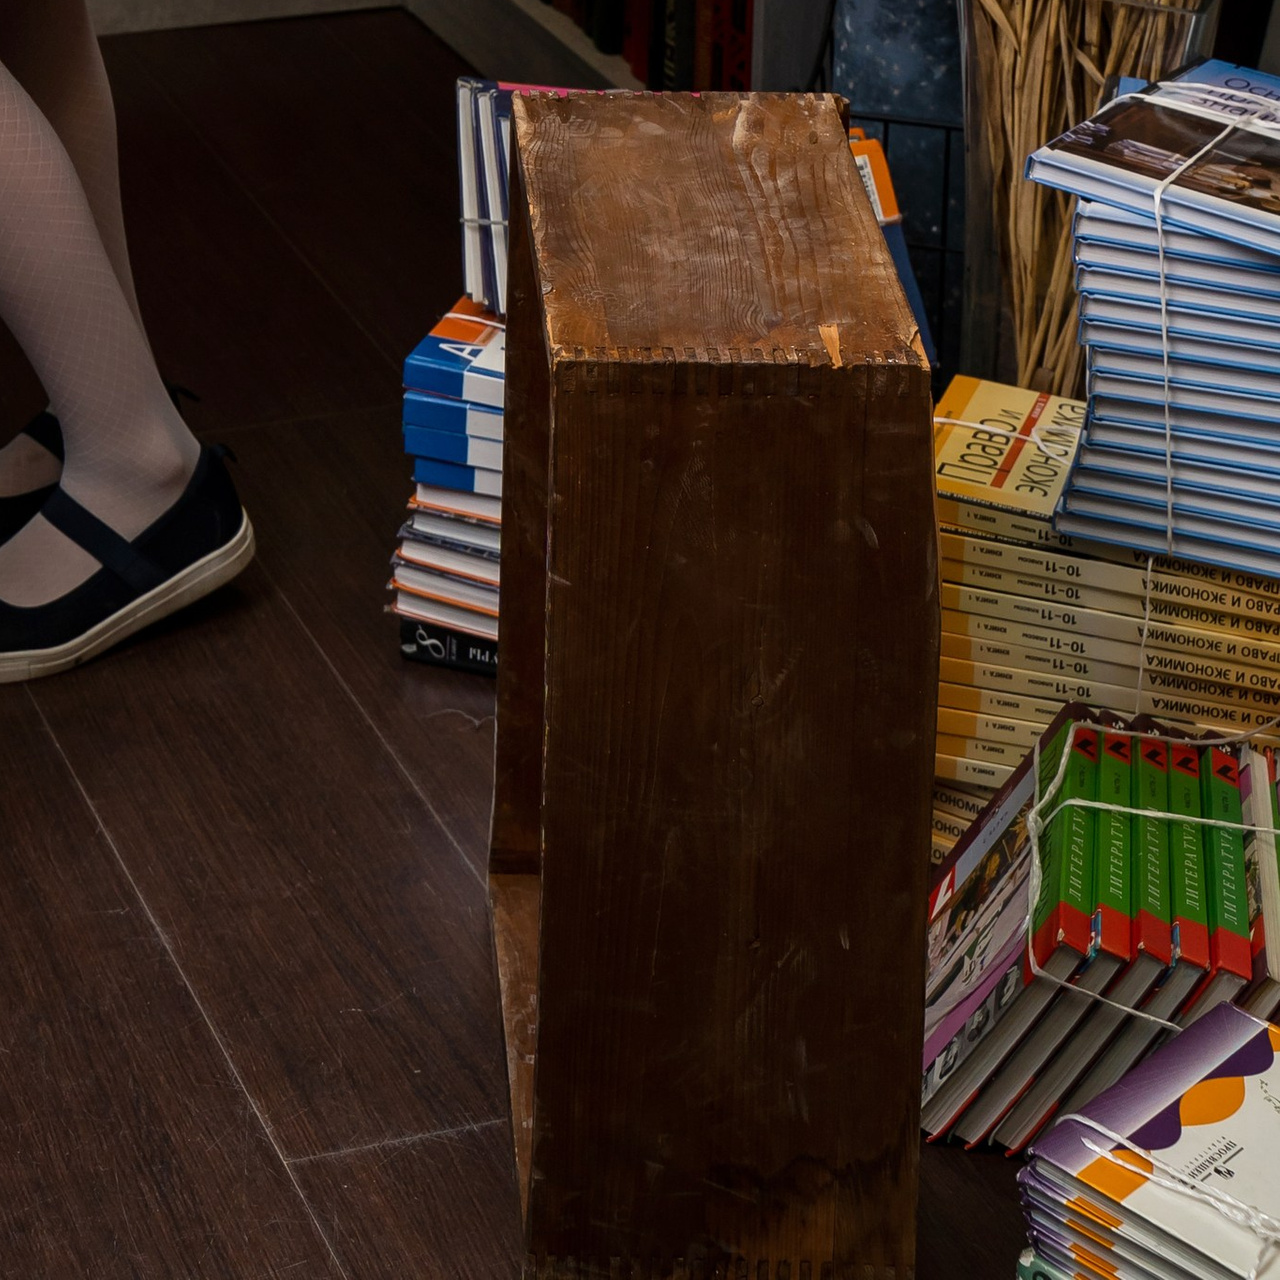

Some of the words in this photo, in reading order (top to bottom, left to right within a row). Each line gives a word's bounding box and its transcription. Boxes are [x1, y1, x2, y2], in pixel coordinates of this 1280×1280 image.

[937, 418, 1018, 486] Право
[973, 513, 996, 524] КНИГА
[979, 547, 1002, 557] КНИГА
[979, 570, 1002, 580] КНИГА
[1221, 571, 1231, 583] И
[1142, 578, 1228, 604] ЭКОНОМИКА
[975, 595, 998, 605] КНИГА
[1231, 596, 1241, 608] И
[1140, 600, 1226, 626] ЭКОНОМИКА
[1246, 599, 1280, 616] РАВО
[1230, 616, 1240, 628] И
[1245, 620, 1280, 636] РАВО
[984, 624, 1007, 633] КНИГА
[1137, 626, 1223, 652] ЭКОНОМИКА
[986, 646, 1010, 656] КНИГА
[1227, 643, 1236, 655] И
[1146, 654, 1231, 679] ЭКОНОМИКА
[989, 670, 1013, 680] КНИГА
[1235, 671, 1245, 683] И
[1149, 673, 1234, 698] ЭКОНОМИКА
[1238, 688, 1248, 700] И
[996, 699, 1019, 709] КНИГА
[1152, 697, 1237, 723] ЭКОНОМИКА
[1241, 712, 1251, 724] И
[992, 722, 1015, 732] КНИГА
[982, 745, 1005, 754] КНИГА
[972, 766, 995, 776] КНИГА
[1109, 804, 1124, 899] ЛИТЕРАТУР
[1183, 820, 1200, 911] ЛИТЕРАТУР
[1220, 825, 1238, 925] ЛИТЕРАТУР
[1186, 1139, 1238, 1180] ПРОСВЕЩЕН
